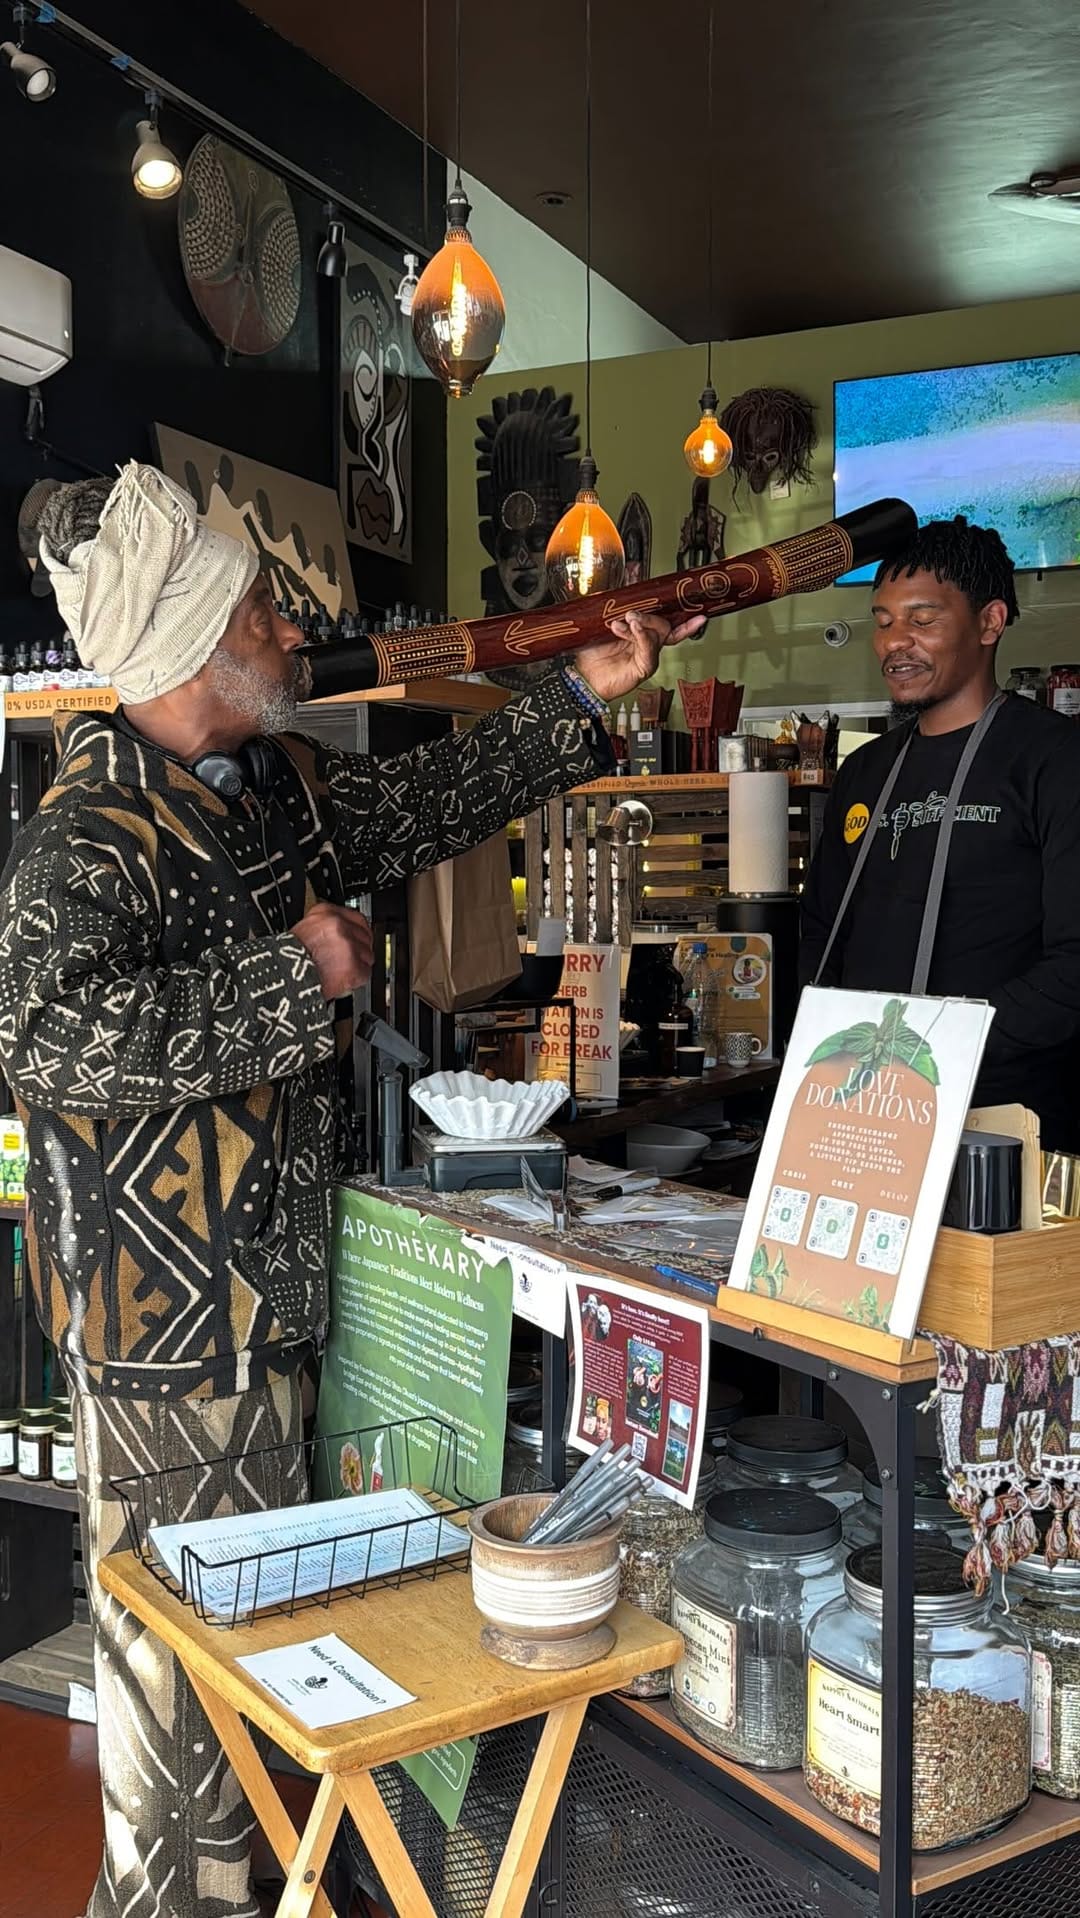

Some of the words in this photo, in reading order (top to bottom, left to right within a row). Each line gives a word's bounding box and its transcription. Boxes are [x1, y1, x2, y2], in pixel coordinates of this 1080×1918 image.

[25, 699, 52, 710] USDA
[56, 696, 112, 708] CERTIFIED
[911, 804, 1001, 827] SUFFCIENT
[566, 953, 606, 973] RRY
[542, 1006, 590, 1019] TATION
[592, 1007, 604, 1020] IS
[542, 1022, 600, 1039] CLOSED
[531, 1040, 560, 1056] FOR
[563, 1042, 612, 1060] BREAK
[846, 1067, 905, 1098] LOVE
[805, 1082, 934, 1126] DONATIONS
[832, 1130, 886, 1146] APPRECIATED!
[832, 1137, 846, 1147] YOU
[849, 1140, 866, 1151] FEEL
[858, 1126, 898, 1140] EXCHANGE
[816, 1151, 842, 1163] LITTLE
[844, 1157, 857, 1166] TIP
[860, 1160, 884, 1172] KEEPS
[886, 1165, 902, 1175] THE
[341, 1248, 361, 1265] Where
[361, 1255, 388, 1276] Japanese
[389, 1264, 418, 1284] Traditions
[419, 1275, 432, 1290] Meet
[433, 1281, 455, 1299] Modern
[456, 1290, 483, 1311] Wellness
[697, 1617, 728, 1646] NATURALS
[703, 1654, 719, 1674] Tea
[709, 1643, 731, 1667] Mint
[308, 1644, 328, 1661] Need
[327, 1659, 336, 1667] A
[333, 1664, 387, 1706] Consultation?
[846, 1692, 880, 1718] NATURALS
[818, 1697, 845, 1720] Heart
[846, 1713, 880, 1737] Smart
